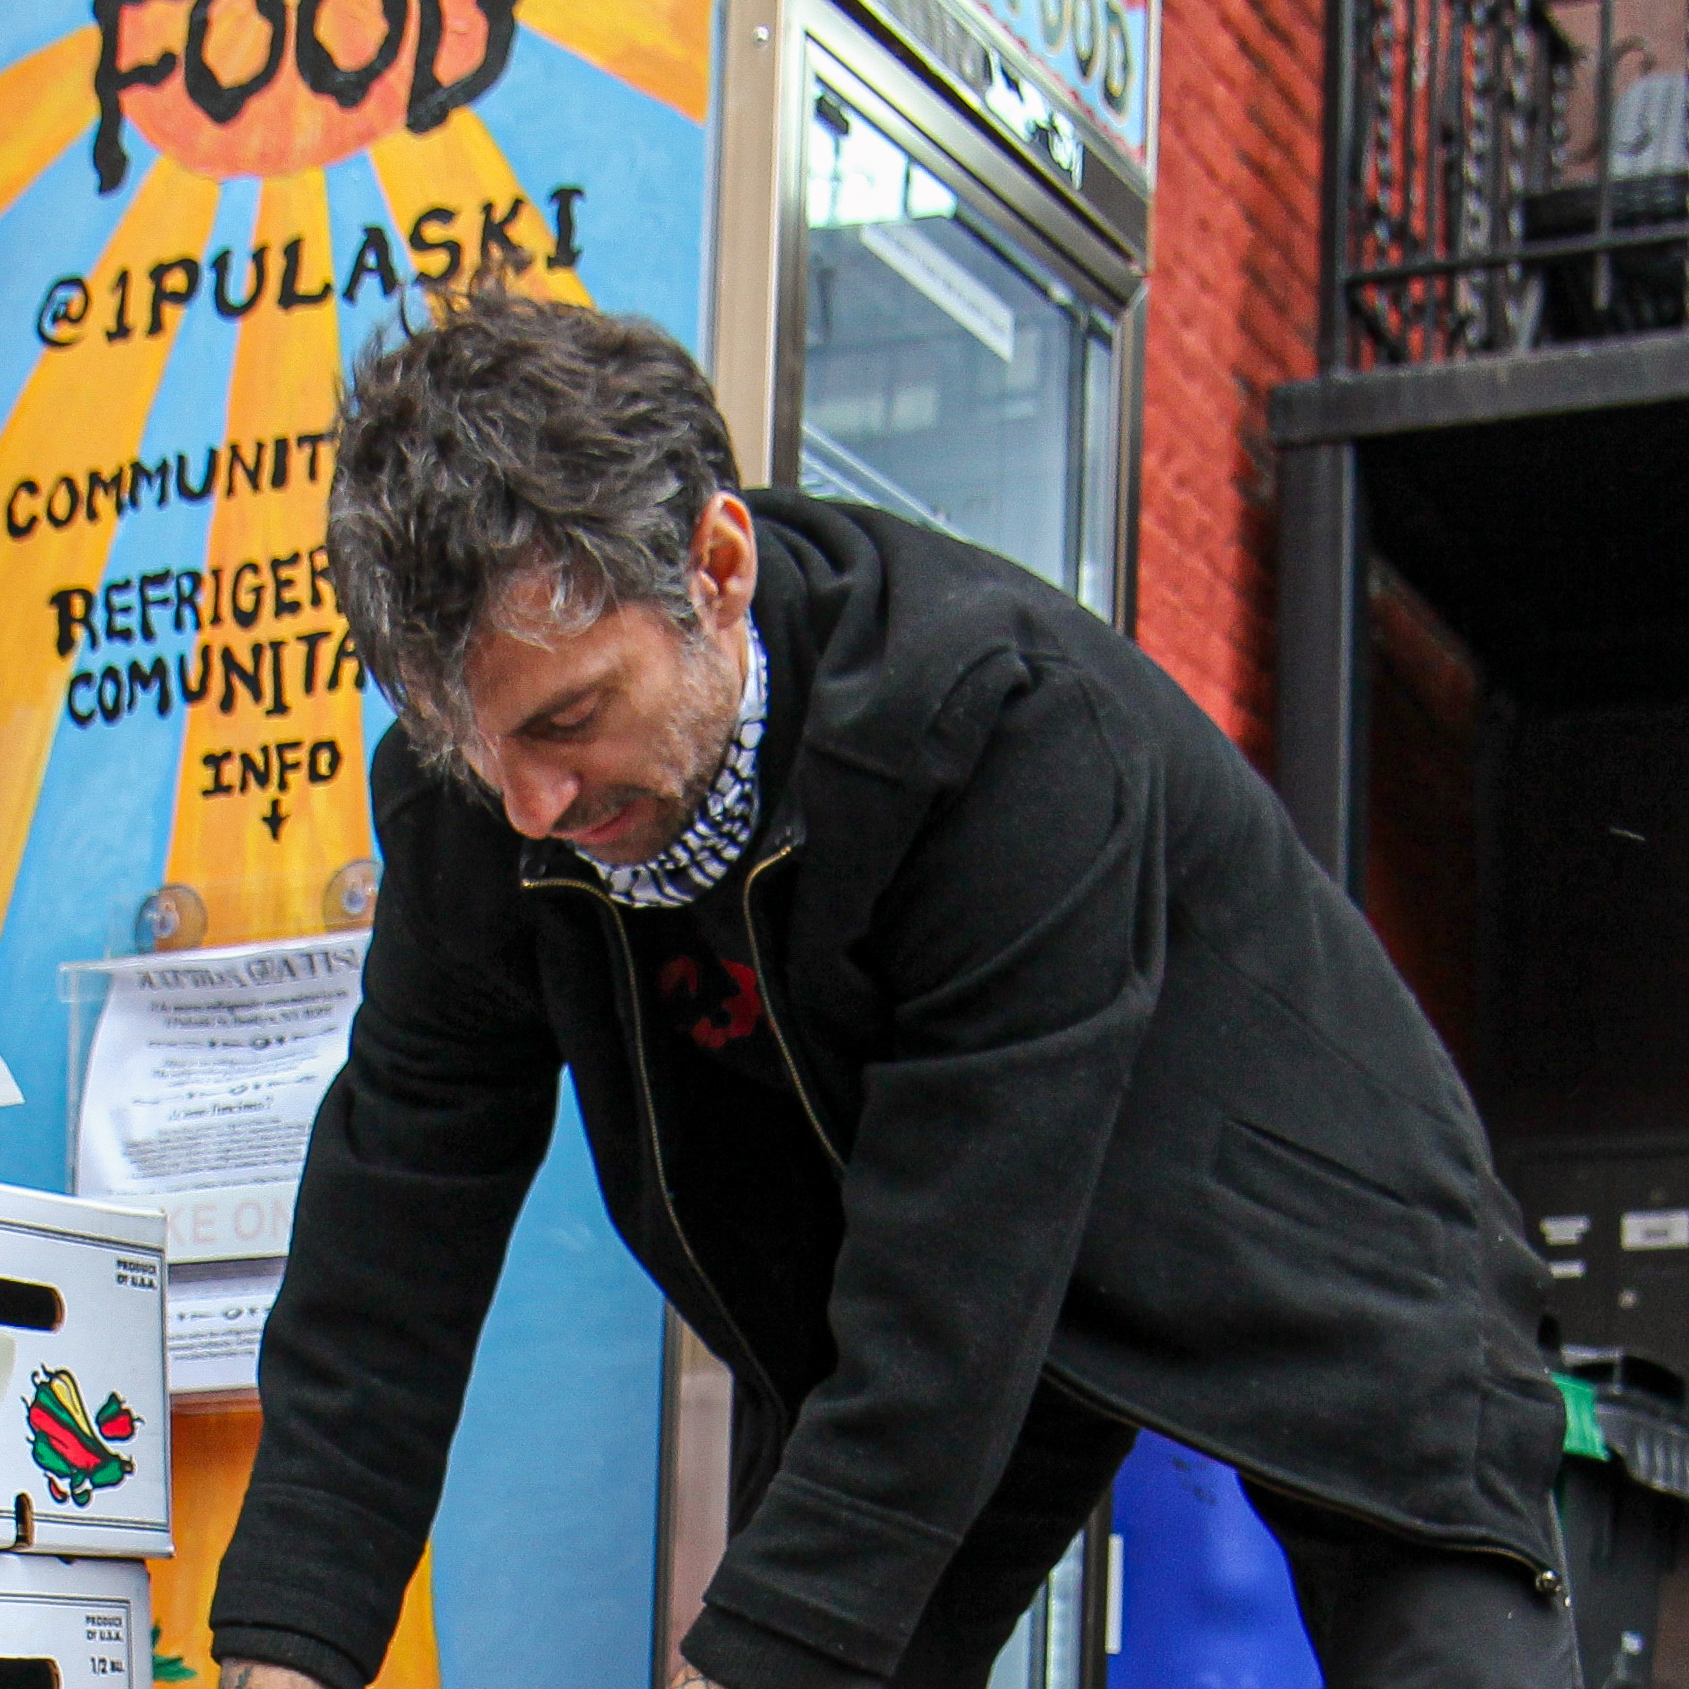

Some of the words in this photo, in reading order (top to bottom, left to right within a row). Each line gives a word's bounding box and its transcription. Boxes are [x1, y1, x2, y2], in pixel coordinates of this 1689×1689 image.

[92, 0, 515, 195] FOOD
[35, 186, 587, 349] @1PULASKI
[4, 432, 339, 539] COMMUNIT
[49, 544, 333, 660] REFRIGER
[65, 630, 367, 729] COMUNITA
[200, 739, 343, 797] INFO
